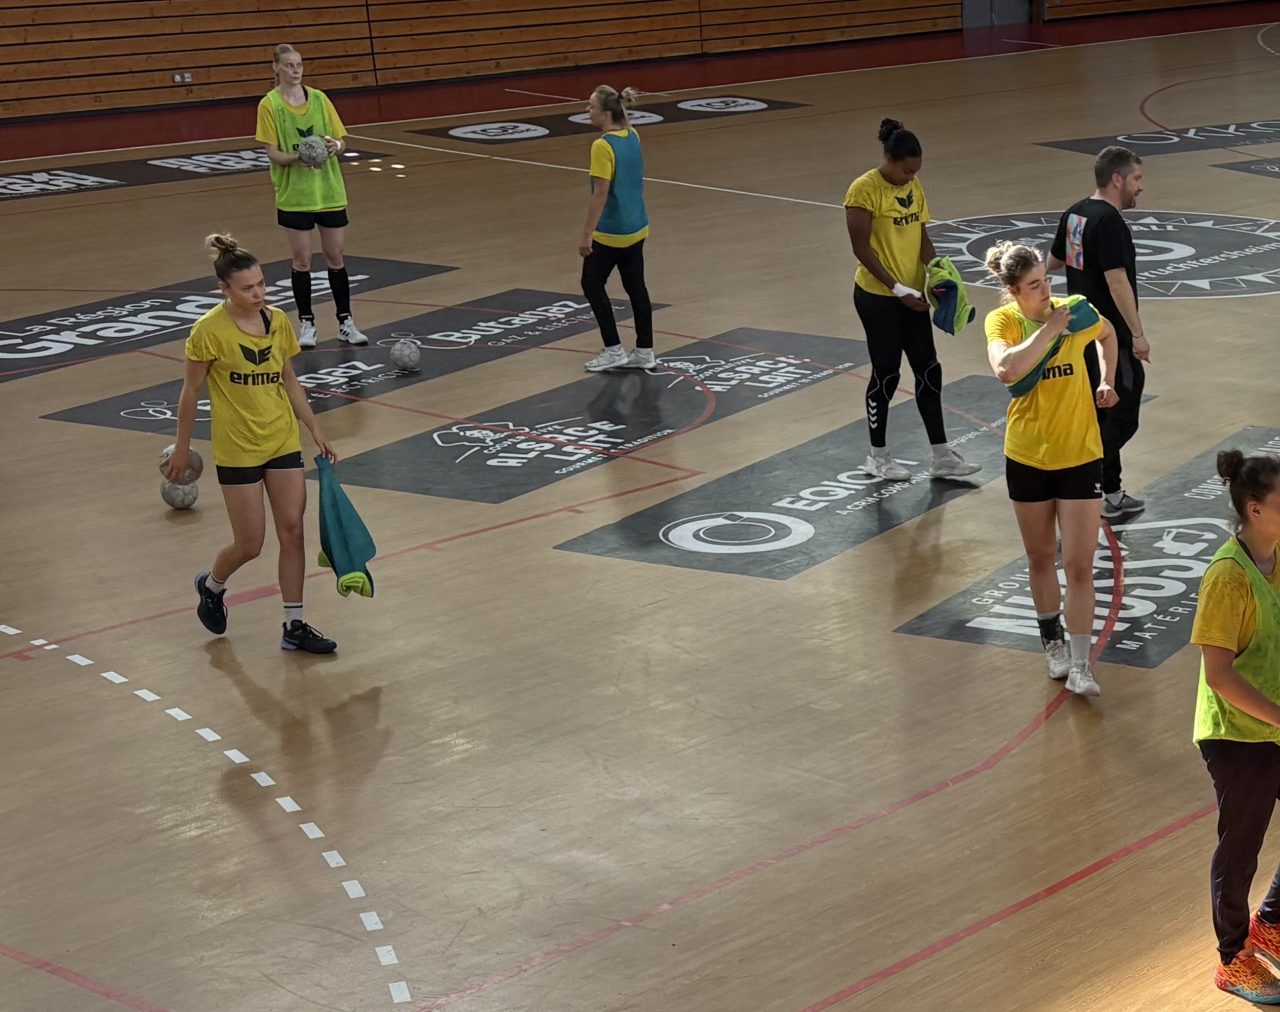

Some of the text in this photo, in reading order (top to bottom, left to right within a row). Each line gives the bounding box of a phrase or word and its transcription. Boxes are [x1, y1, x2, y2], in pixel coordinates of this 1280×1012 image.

[0, 298, 172, 337] La Région
[0, 295, 228, 359] Grand
[427, 300, 591, 343] Butagaz
[229, 369, 281, 386] erima
[744, 367, 812, 388] LAIT
[544, 434, 625, 461] LAIT
